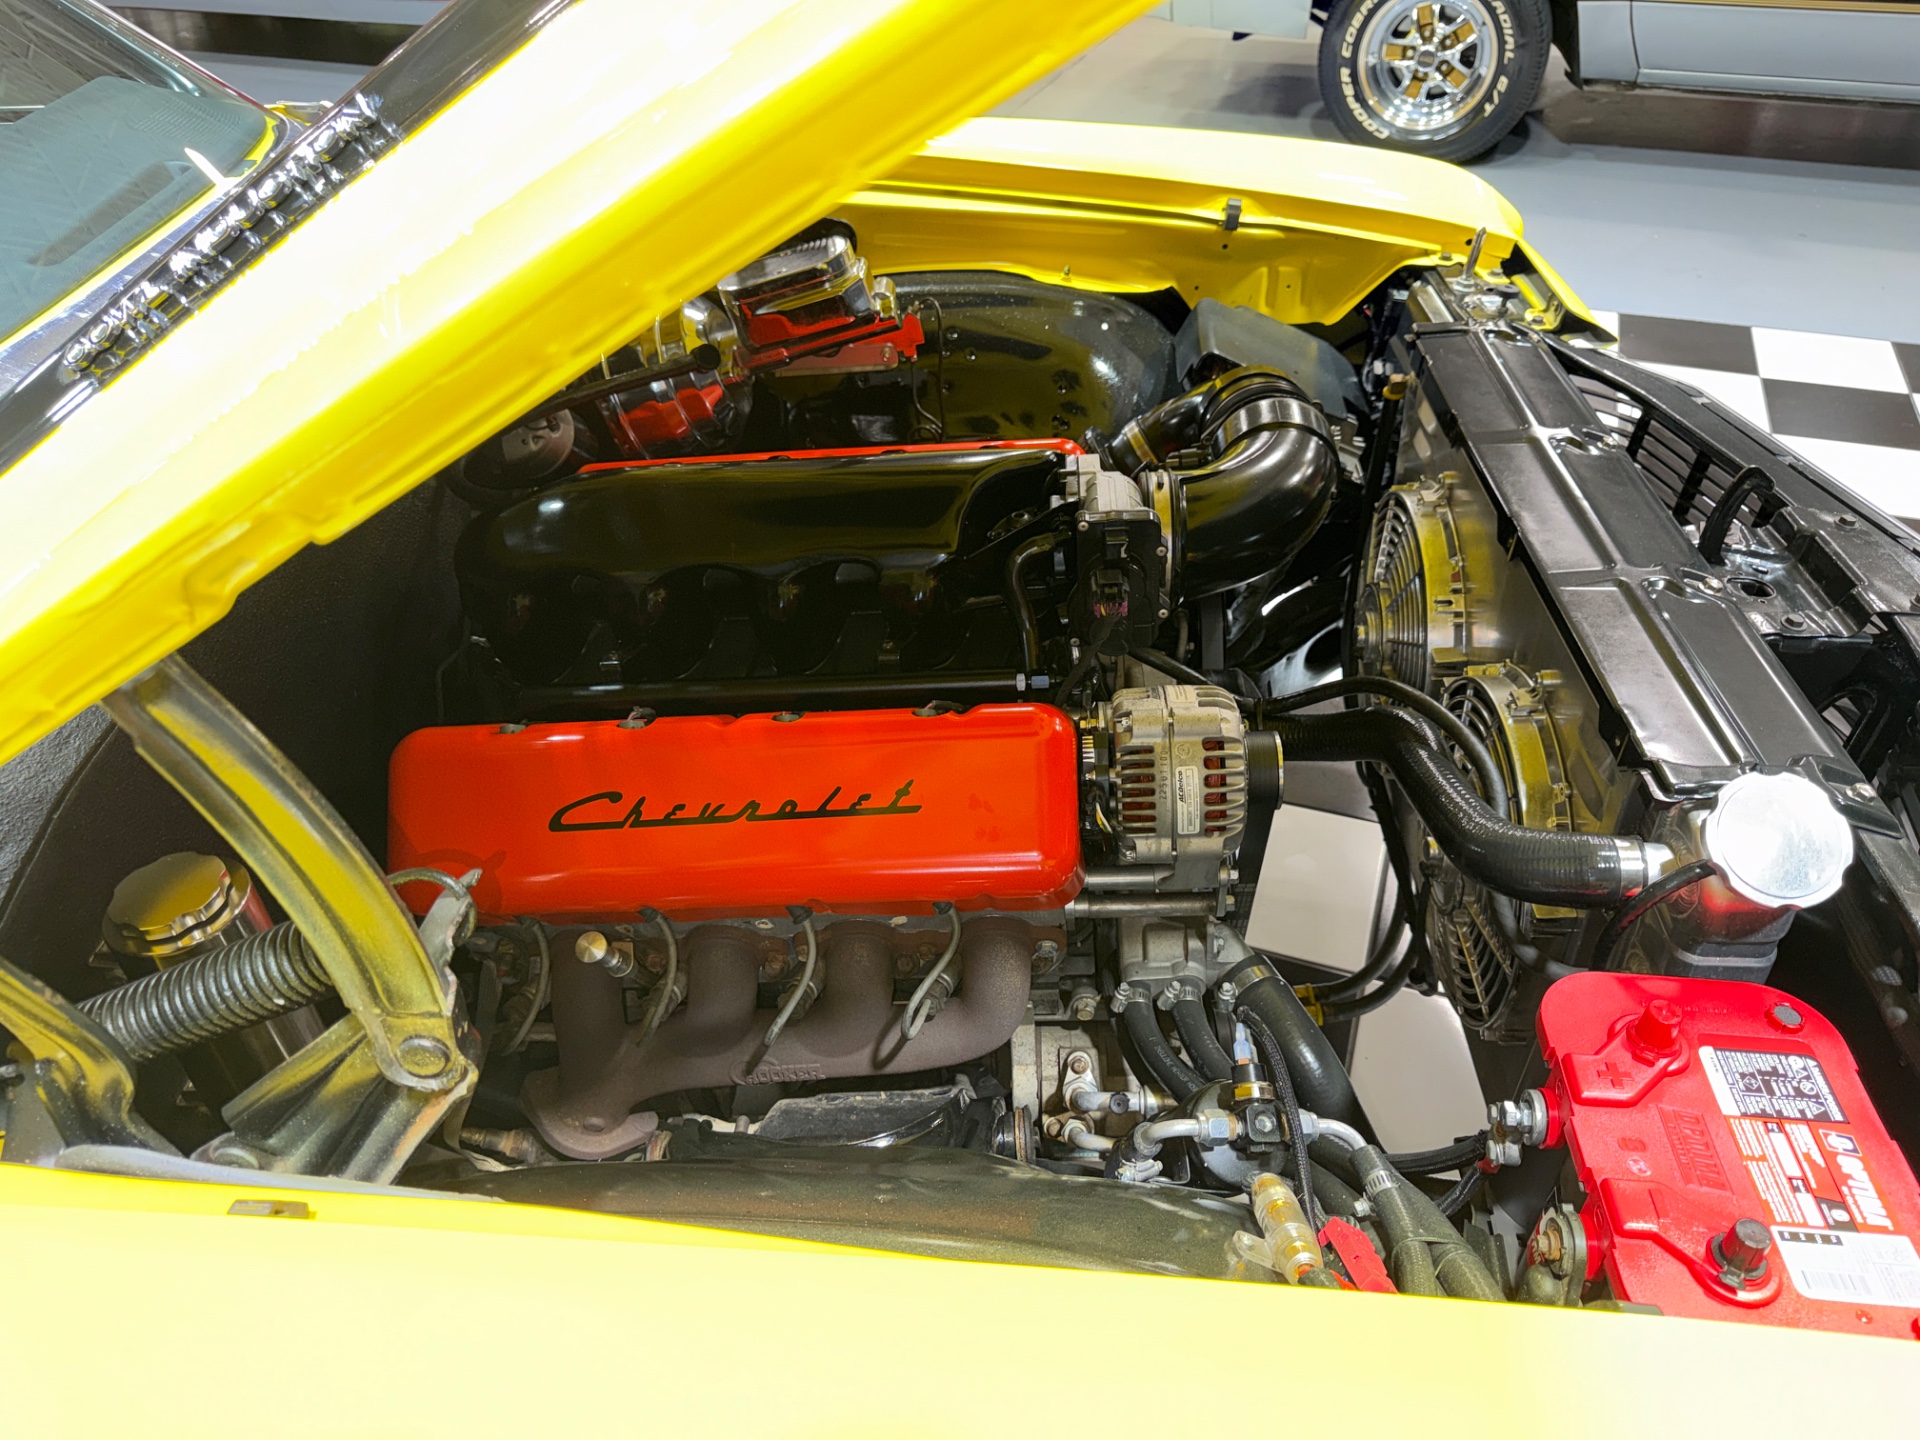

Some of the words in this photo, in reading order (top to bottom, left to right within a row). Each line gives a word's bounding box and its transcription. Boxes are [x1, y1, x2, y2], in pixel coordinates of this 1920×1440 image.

[1341, 0, 1378, 58] COBR
[1489, 0, 1515, 64] ADIAL
[1340, 67, 1390, 139] COOPER
[548, 778, 923, 832] Chevrolet
[1836, 1154, 1893, 1227] OPTIMA
